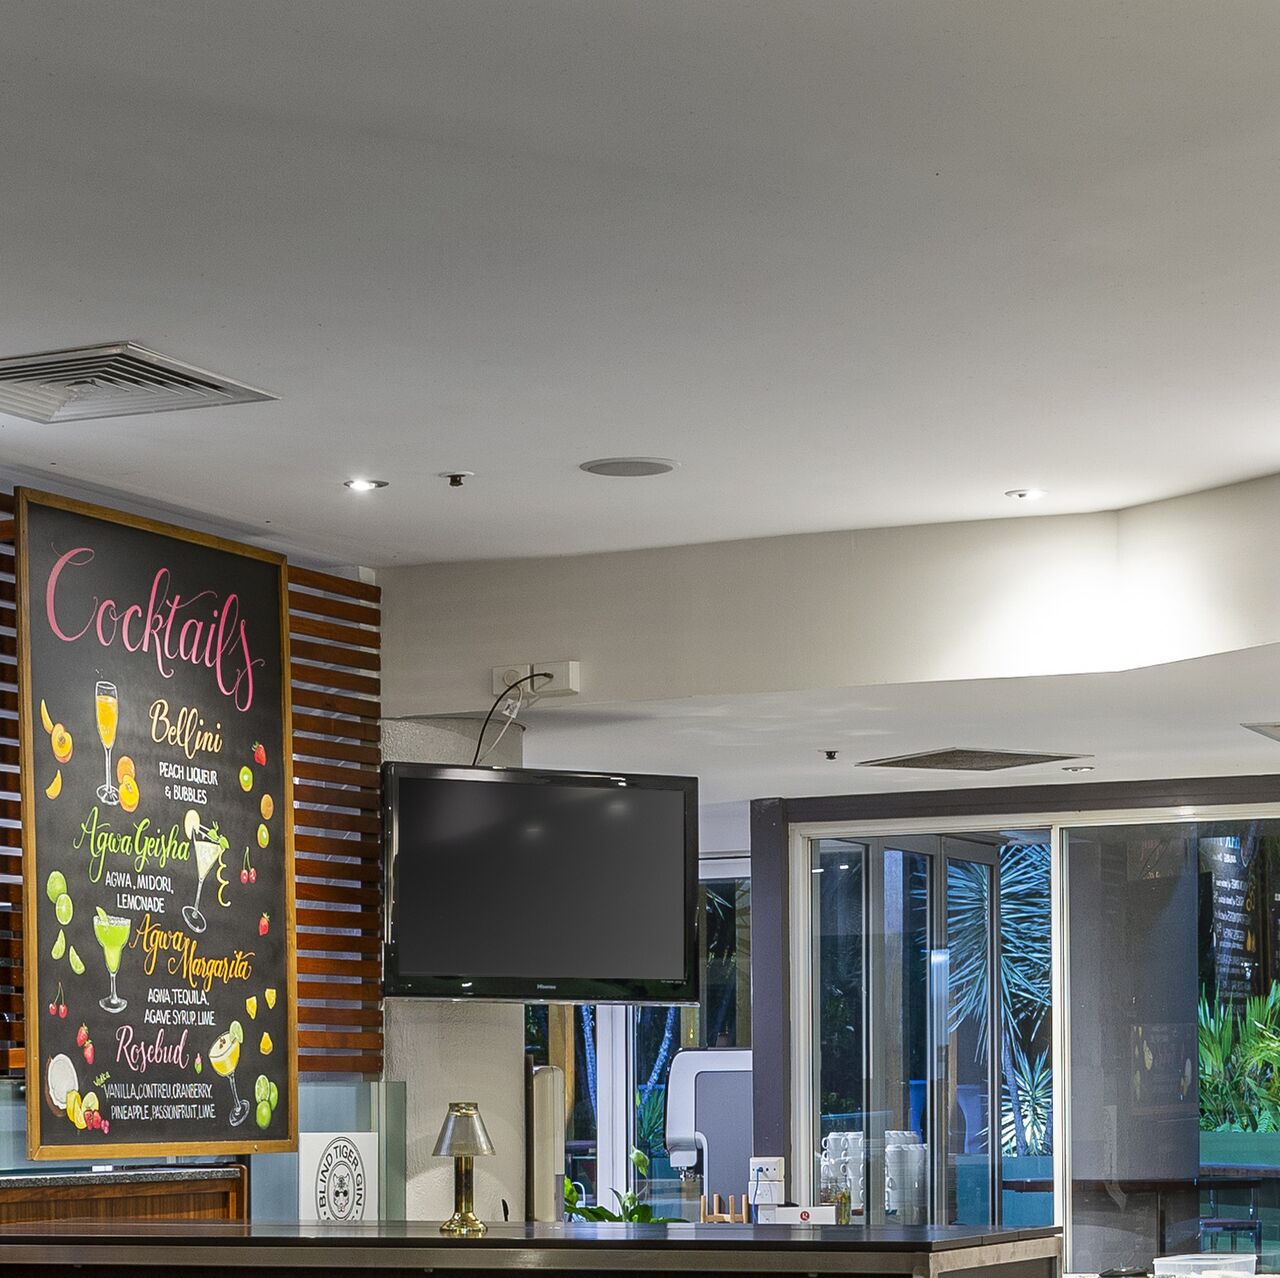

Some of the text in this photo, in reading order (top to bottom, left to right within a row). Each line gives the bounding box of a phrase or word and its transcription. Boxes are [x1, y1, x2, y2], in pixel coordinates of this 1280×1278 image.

[46, 542, 265, 712] Cocktails
[148, 699, 222, 759] Bellini
[159, 762, 218, 785] PEACH LIQUEUR
[165, 785, 207, 805] & BUBBLES
[73, 806, 189, 883] Agwa Geisha
[117, 896, 165, 913] LEMONADE
[129, 913, 183, 975] Agwa
[168, 939, 255, 992] Margarita
[144, 1009, 171, 1024] AGAVE
[198, 1011, 216, 1025] LIME
[116, 1025, 189, 1073] Rosebud
[199, 1104, 216, 1119] LIME
[319, 1152, 333, 1208] BLIND
[334, 1145, 358, 1172] TIGER
